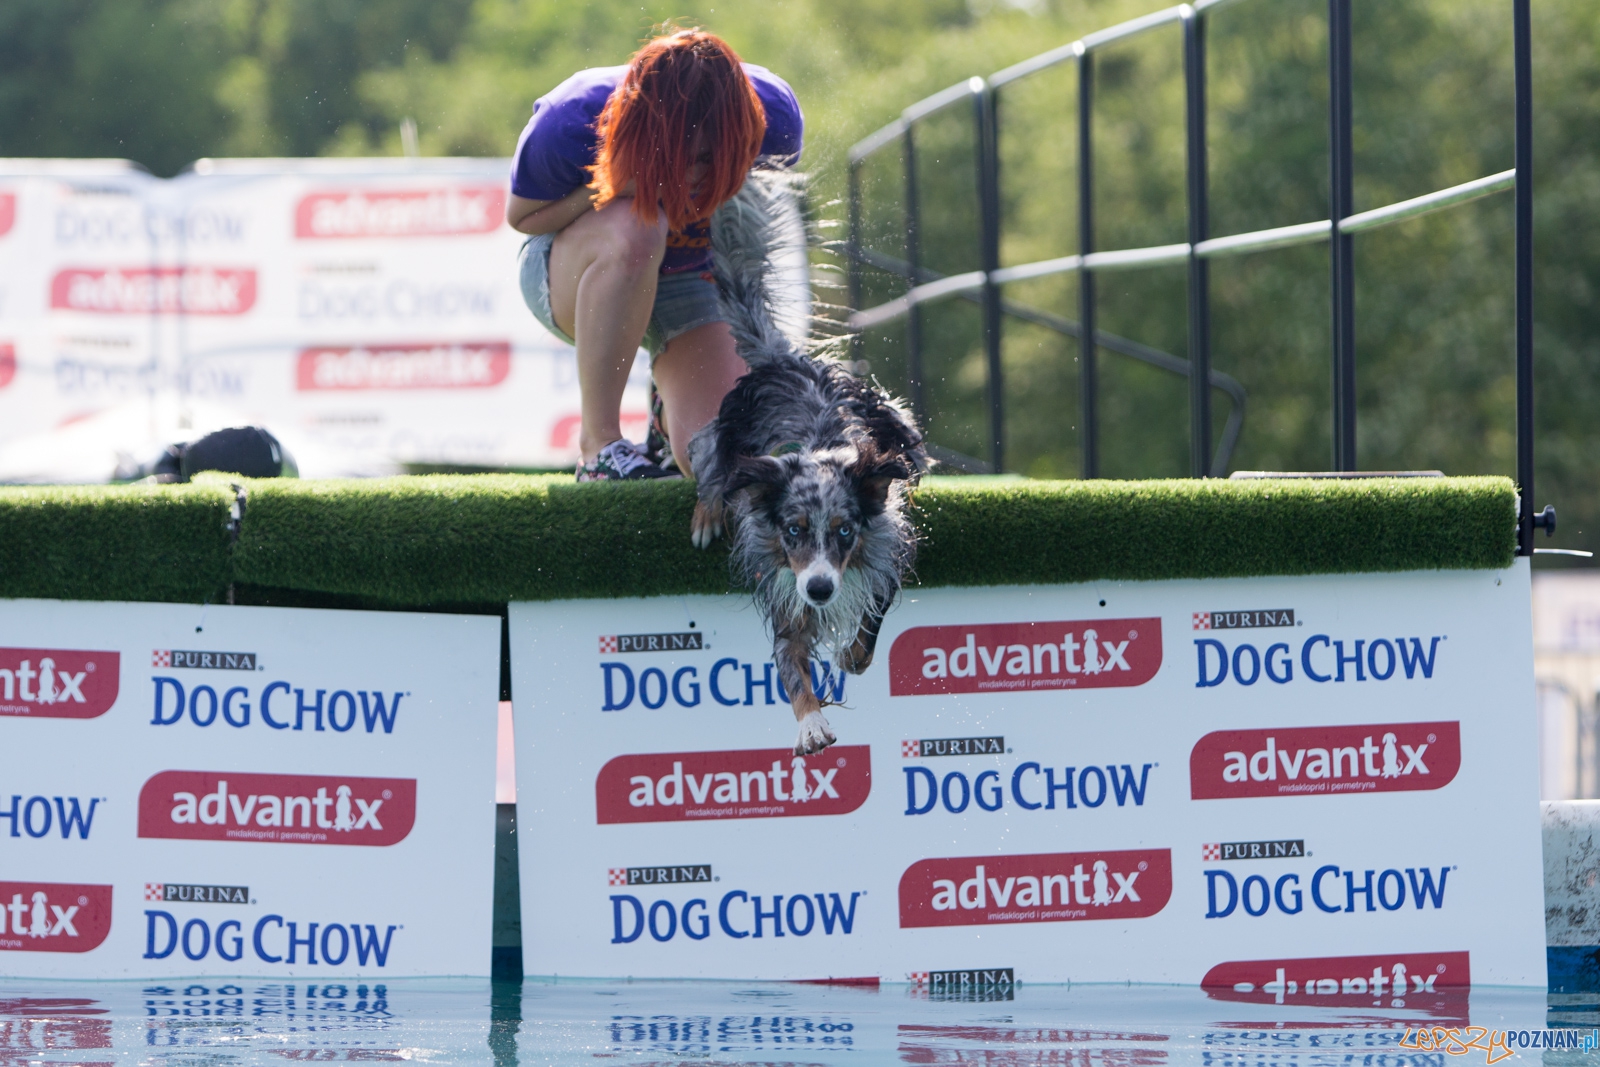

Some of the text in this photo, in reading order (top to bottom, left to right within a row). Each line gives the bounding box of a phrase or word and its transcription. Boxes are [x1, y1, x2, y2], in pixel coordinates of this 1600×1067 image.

[1214, 611, 1292, 628] PURINA
[621, 634, 700, 650] PURINA
[173, 652, 253, 669] PURINA
[921, 628, 1132, 679] advantix
[1193, 633, 1441, 688] DOG CHOW
[599, 661, 702, 712] DOG
[978, 678, 1026, 690] imidakloprid
[1031, 677, 1077, 688] permetryna
[150, 676, 405, 734] DOG CHOW
[923, 738, 1002, 755] PURINA
[1222, 732, 1430, 783] advantix
[628, 756, 840, 808] advantix
[902, 761, 1153, 816] DOG CHOW
[1278, 781, 1325, 793] imidakloprid
[1331, 781, 1376, 791] permetryna
[170, 780, 384, 832] advantix
[685, 805, 733, 817] imidakloprid
[738, 805, 785, 816] permetryna
[226, 828, 275, 841] imidakloprid
[280, 831, 327, 841] permetryna
[1223, 842, 1302, 858] PURINA
[630, 867, 709, 884] PURINA
[166, 885, 246, 902] PURINA
[931, 860, 1142, 911] advantix
[1203, 864, 1451, 919] DOG CHOW
[609, 889, 861, 945] DOG CHOW
[987, 909, 1035, 921] imidakloprid
[1040, 909, 1087, 920] permetryna
[142, 909, 397, 968] DOG CHOW
[932, 970, 1011, 984] PURINA
